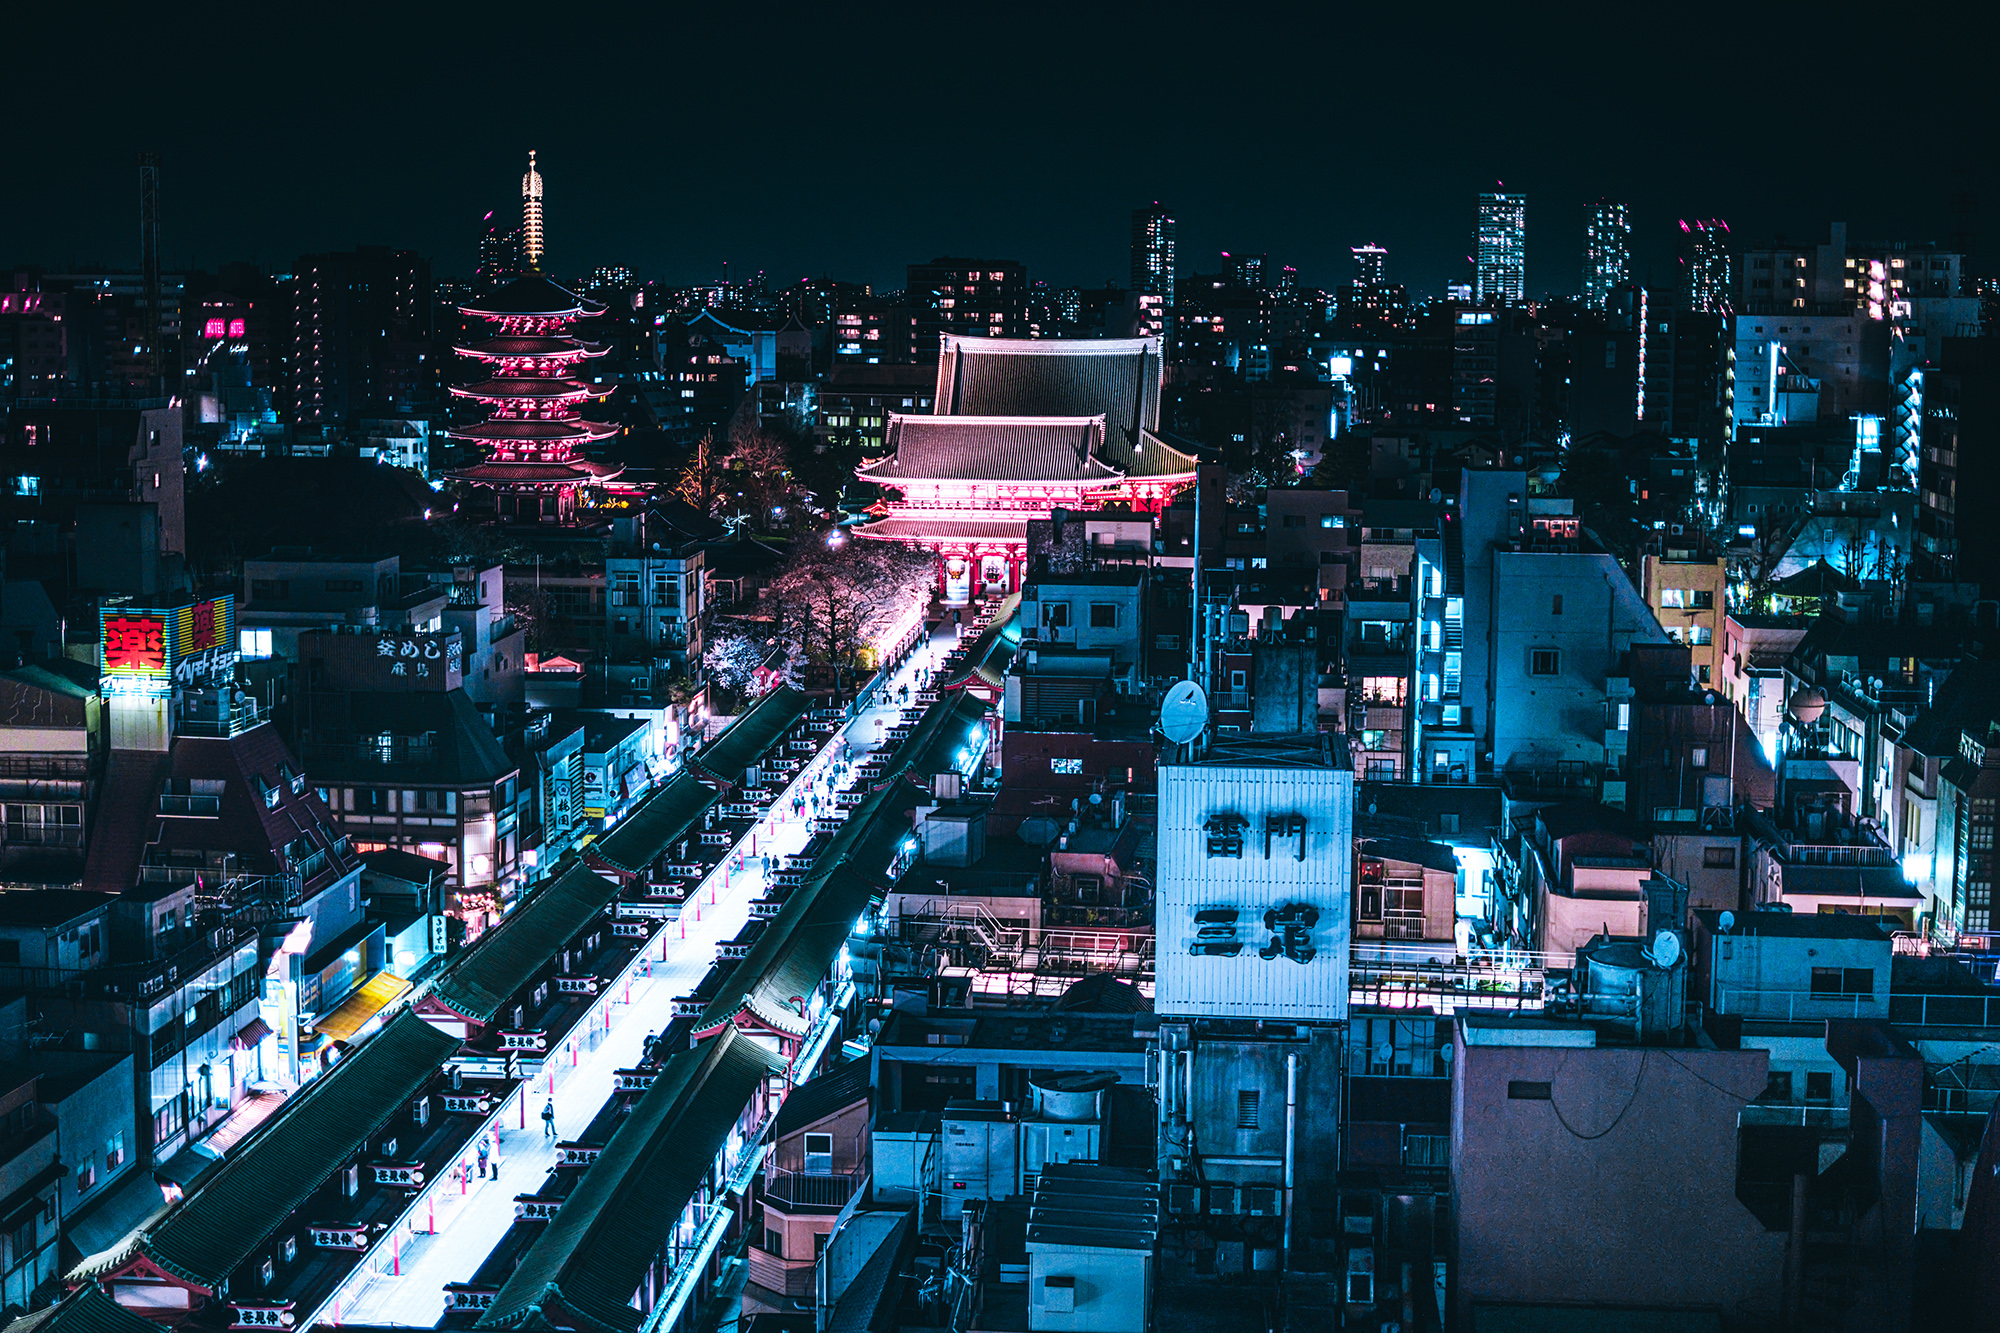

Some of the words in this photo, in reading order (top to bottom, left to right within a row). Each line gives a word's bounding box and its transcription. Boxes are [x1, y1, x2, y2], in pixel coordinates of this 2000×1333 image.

[105, 618, 163, 669] 薬
[192, 601, 216, 651] 薬
[377, 639, 441, 659] 釜めし
[176, 647, 235, 685] マツモトキヨシ
[558, 799, 570, 825] 梅園
[1203, 814, 1307, 862] 雷門
[1190, 903, 1319, 964] 三定
